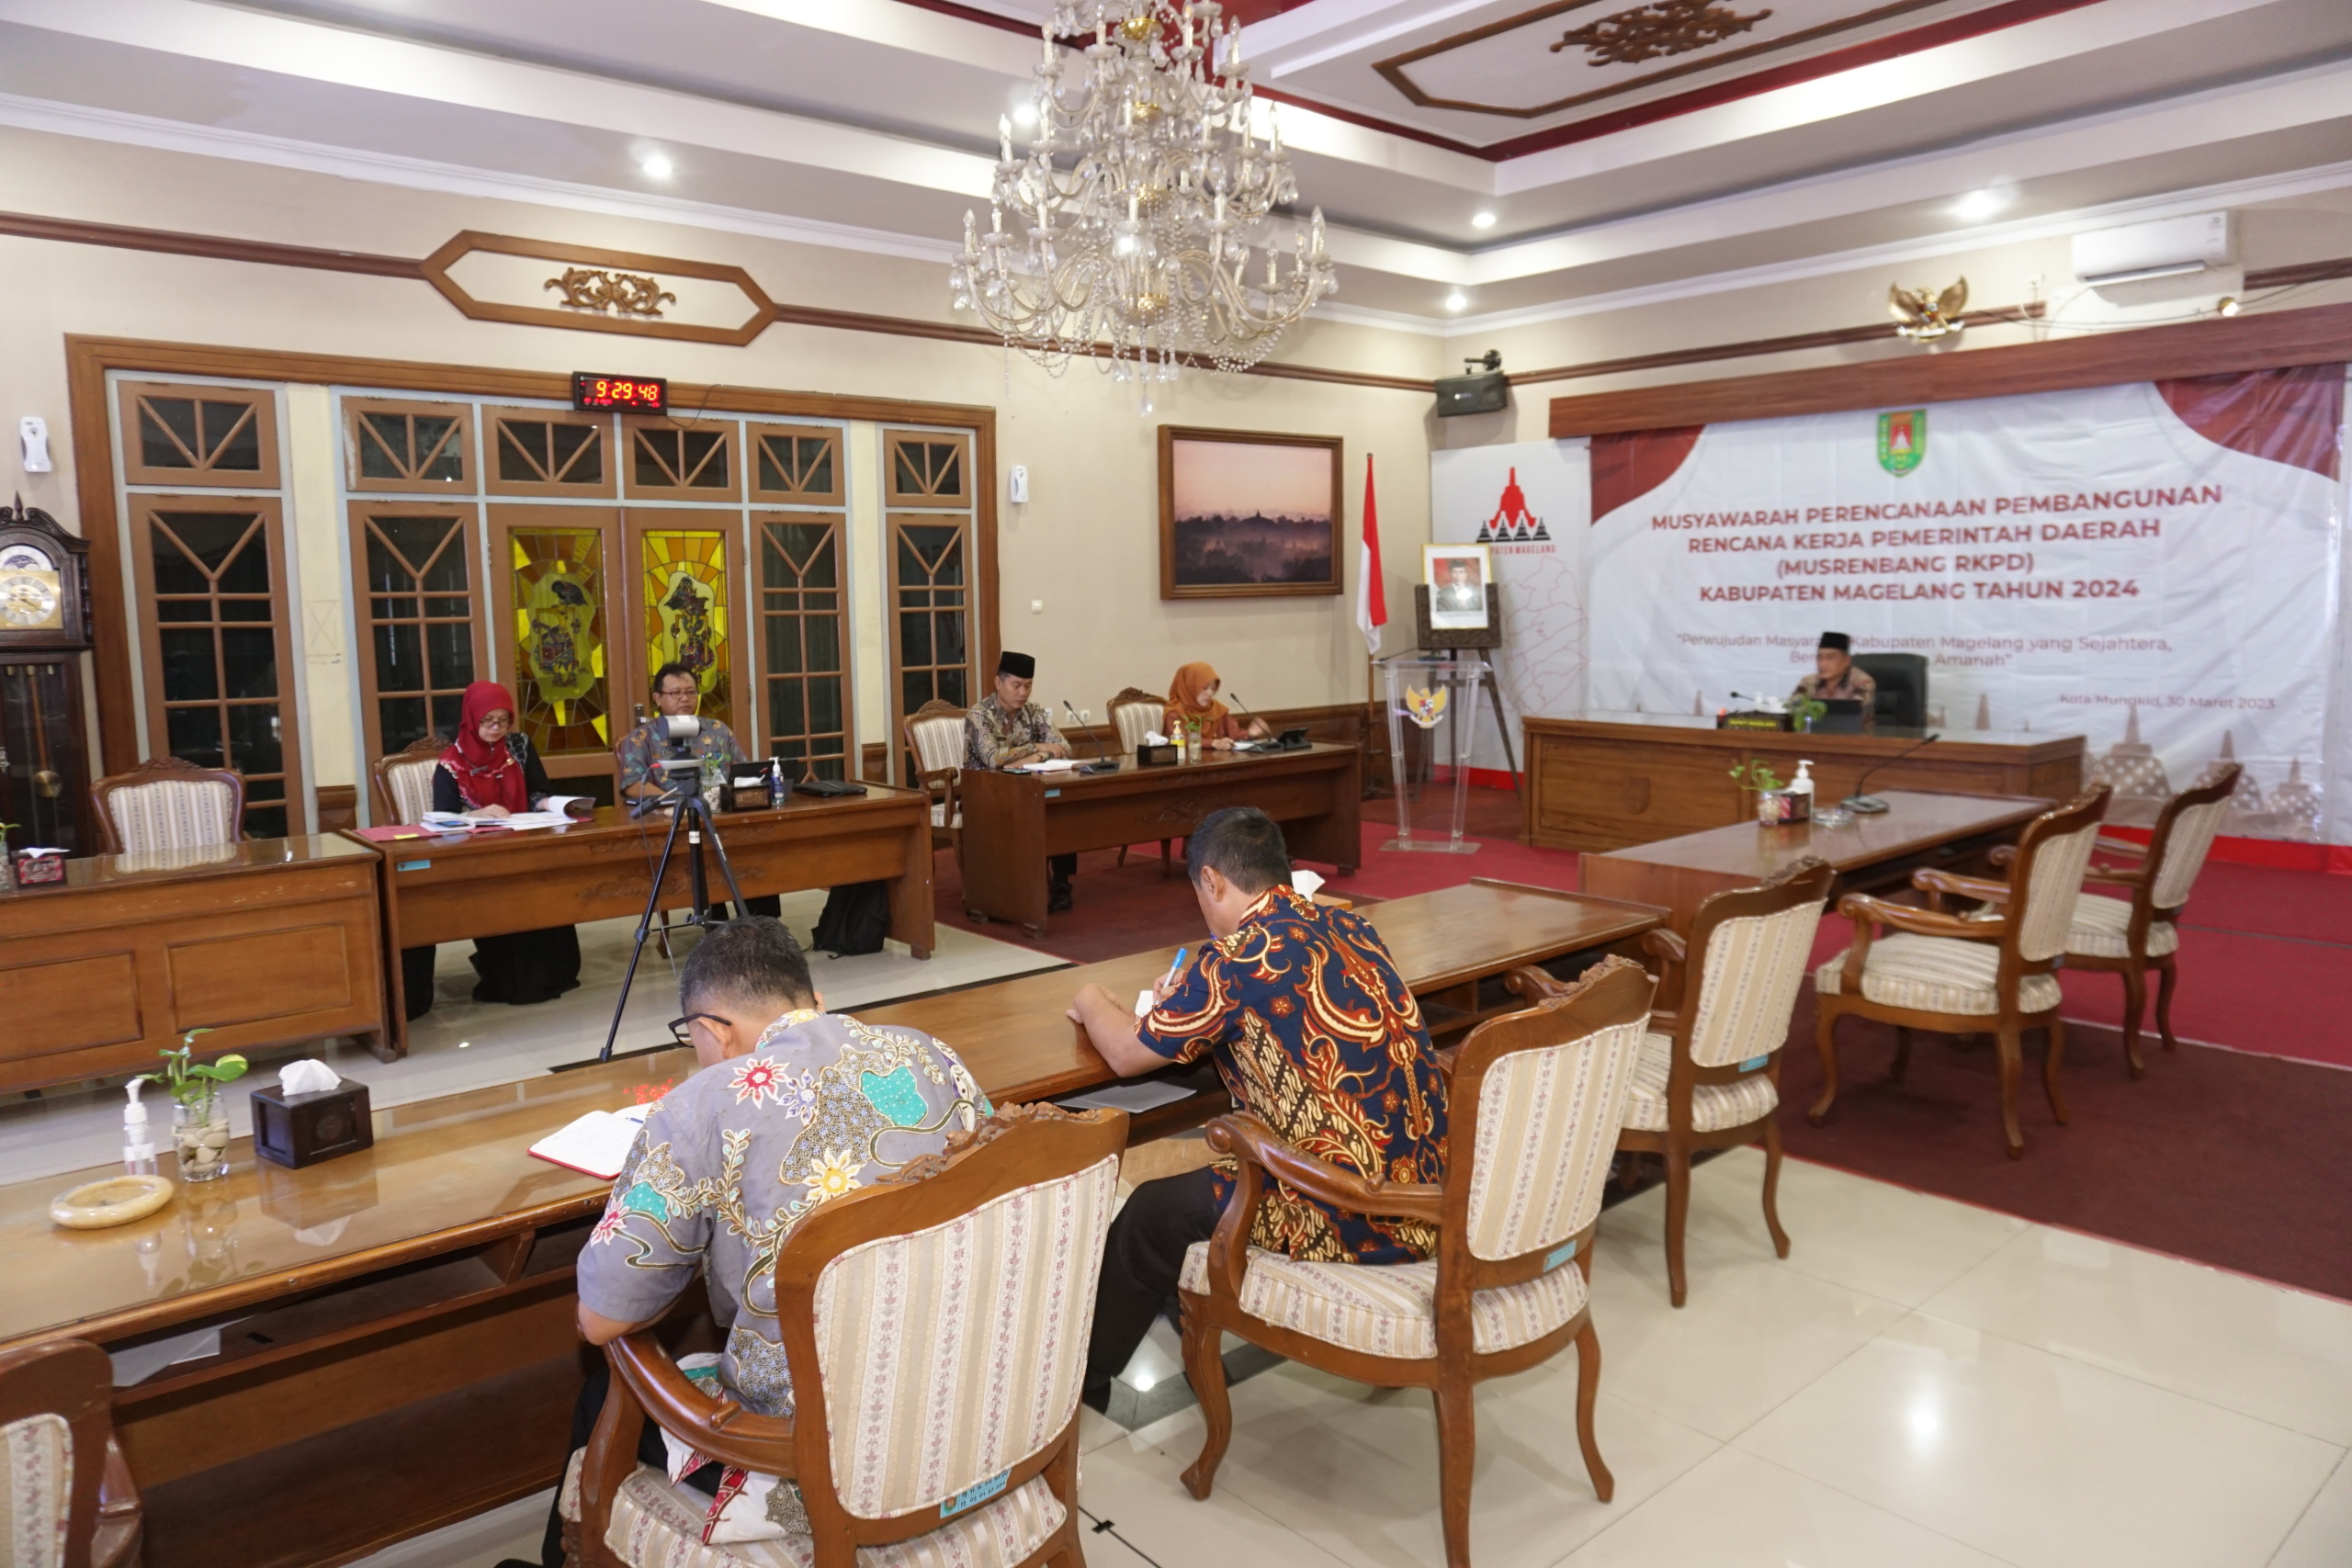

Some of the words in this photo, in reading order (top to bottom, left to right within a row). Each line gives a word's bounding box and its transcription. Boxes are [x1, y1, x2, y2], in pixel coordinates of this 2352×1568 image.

[1651, 508, 1800, 530] MUSYAWARAH
[1805, 499, 1986, 523] PERENCANAAN
[1994, 485, 2222, 514] PEMBANGUNAN
[1688, 536, 1788, 553] RENCANA
[1793, 531, 1865, 550] KERJA
[1871, 525, 2032, 547] PEMERINTAH
[2041, 518, 2161, 542] DAERAH
[1515, 544, 1556, 554] MAGELANG
[1776, 555, 1947, 580] (MUSRENBANG
[1955, 551, 2035, 575] RKPD)
[1700, 584, 1826, 602] KABUPATEN
[1834, 581, 1966, 601] MAGELANG
[1973, 580, 2064, 600] TAHUN
[2071, 579, 2140, 598] 2024
[1851, 634, 1936, 650] Kabupaten
[1940, 636, 2025, 652] Magelang
[2029, 637, 2074, 653] yang
[2078, 636, 2173, 653] Sejahtera,
[2059, 694, 2092, 705] Kota
[2096, 694, 2163, 709] Mungkid,
[2166, 695, 2186, 707] 30
[2190, 696, 2233, 709] Maret
[2238, 697, 2277, 710] 2023
